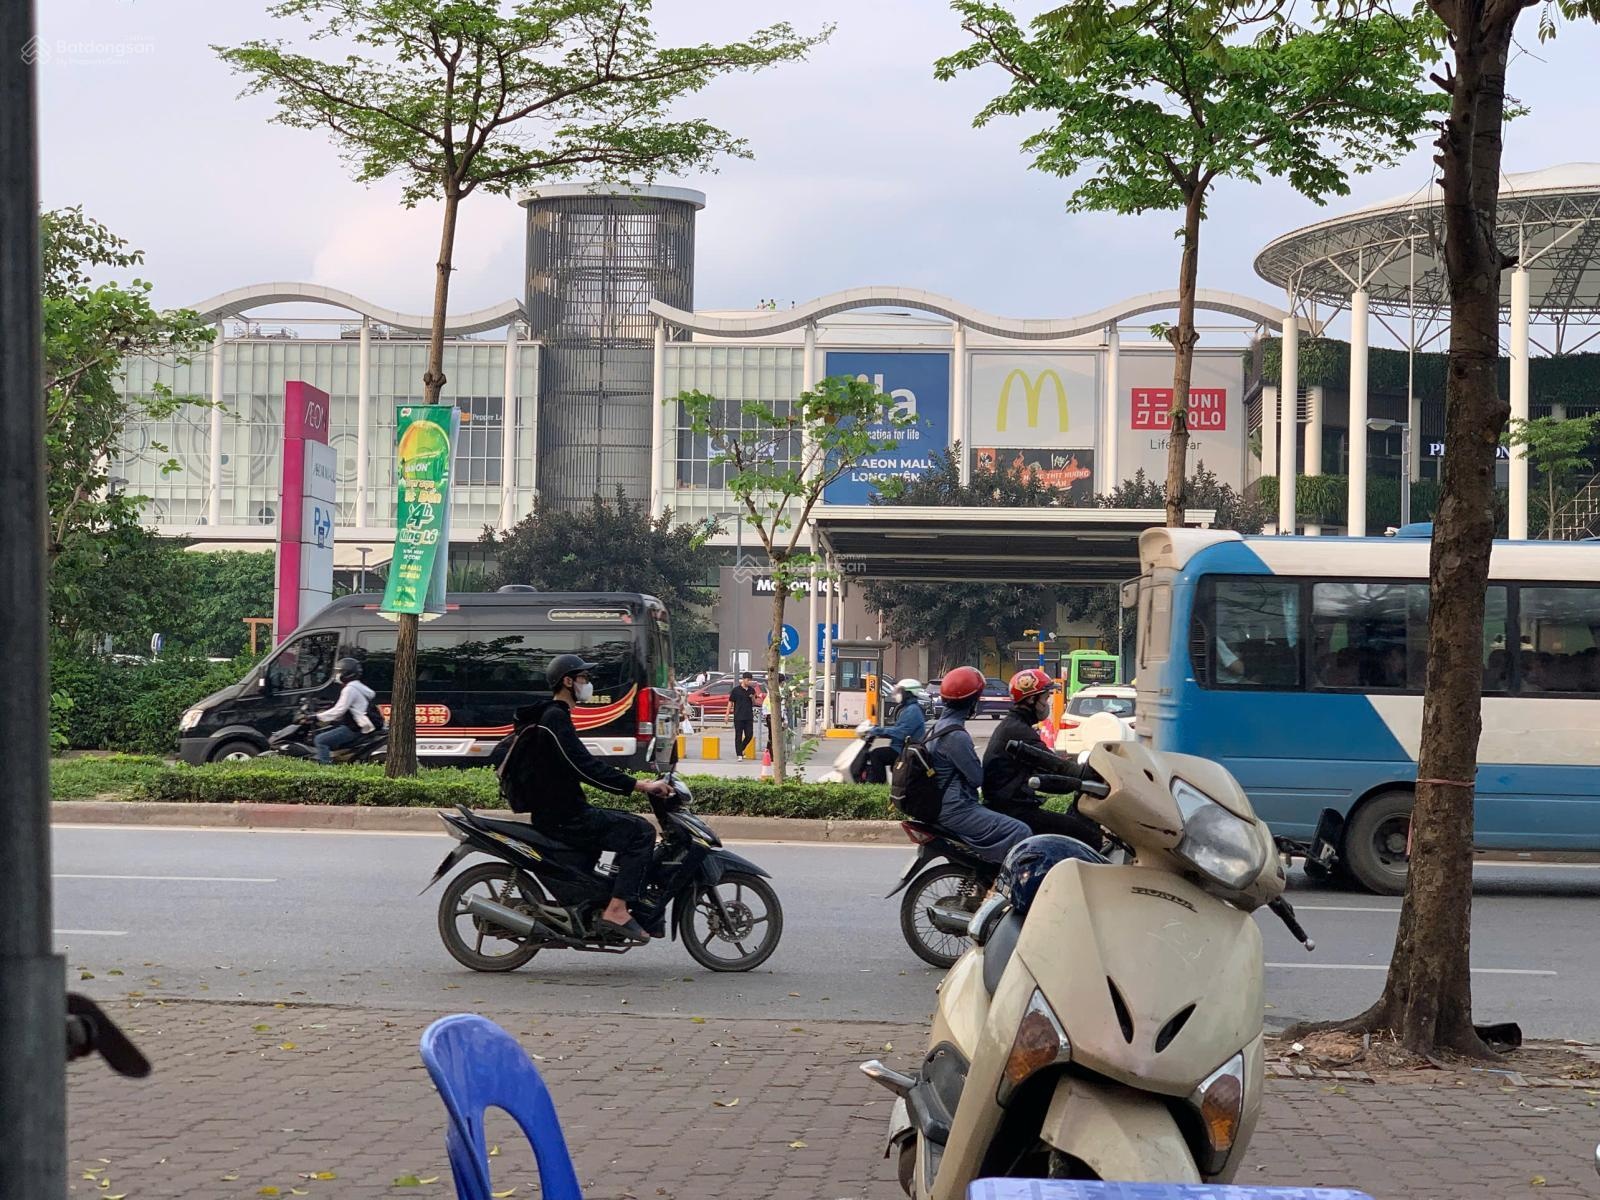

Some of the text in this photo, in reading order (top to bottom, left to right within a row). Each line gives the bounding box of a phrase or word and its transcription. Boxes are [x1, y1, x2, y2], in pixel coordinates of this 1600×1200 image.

[856, 373, 917, 425] la
[1188, 394, 1219, 409] UNI
[1188, 411, 1222, 428] QLO
[906, 428, 920, 440] life
[1150, 439, 1202, 451] Lifeear
[861, 459, 897, 469] AEON
[851, 472, 887, 482] LONG
[756, 579, 840, 593] Mconld's
